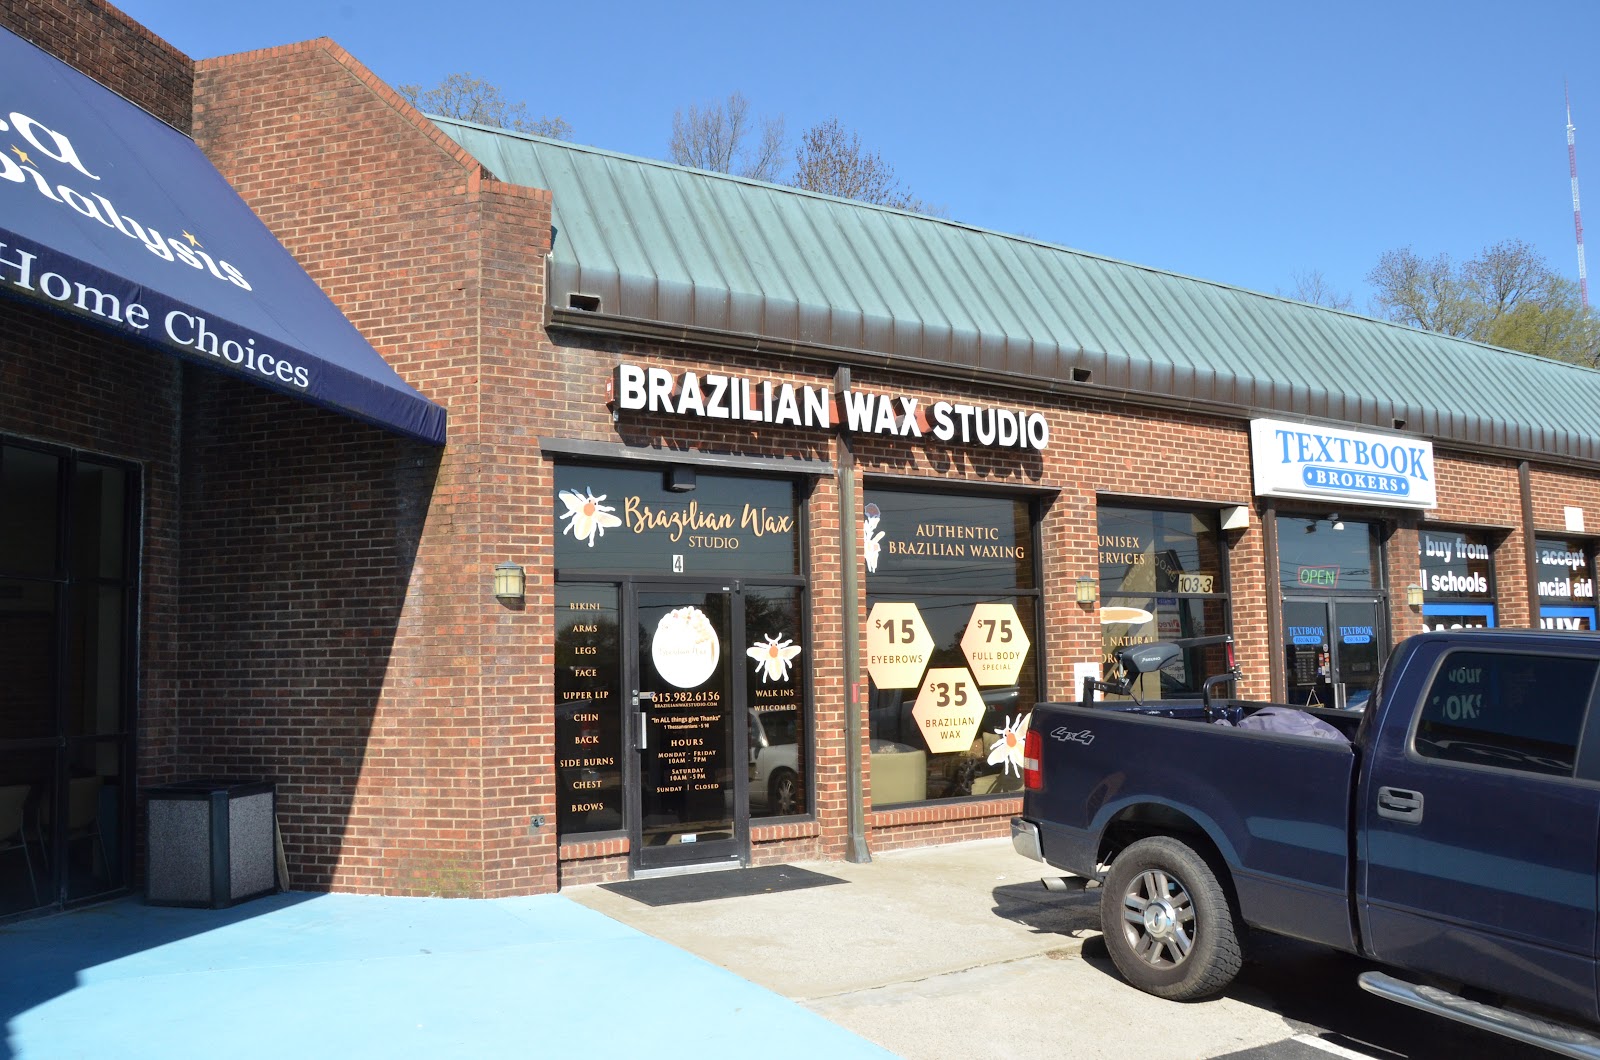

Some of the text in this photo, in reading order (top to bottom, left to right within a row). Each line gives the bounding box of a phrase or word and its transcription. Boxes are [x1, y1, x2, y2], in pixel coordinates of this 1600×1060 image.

[0, 242, 309, 388] Home Choices
[618, 364, 1049, 450] BRAZILIAN WAX STUDIO
[1275, 429, 1428, 481] TEXTBOOK
[1316, 469, 1398, 492] BROKERS
[624, 496, 794, 542] Brazilian Wax
[915, 524, 999, 541] AUTHENTIC
[688, 535, 739, 549] STUDIO
[1097, 535, 1139, 548] UNISEX
[888, 541, 1025, 559] BRAZILIAN WAXING
[1425, 535, 1452, 563] buy
[1455, 537, 1489, 560] from
[674, 555, 682, 572] 4
[1099, 551, 1145, 565] ERVICES
[1541, 548, 1586, 571] accept
[1300, 569, 1335, 585] OPEN
[1431, 570, 1488, 593] schools
[1538, 577, 1593, 597] ncial aid
[570, 602, 600, 610] BIKINI
[572, 624, 598, 633] ARMS
[875, 619, 915, 644] $15
[977, 619, 1013, 643] $75
[1288, 626, 1325, 637] TEXTBOOK
[1339, 626, 1374, 636] TEXTBOOK
[574, 646, 597, 655] LEGS
[972, 651, 1020, 660] FULL BODY
[871, 654, 923, 664] EYEBROWS
[575, 668, 597, 677] FACE
[563, 690, 609, 700] UPPER LIP
[651, 691, 720, 703] 615.982.6156
[755, 688, 795, 697] WALK INS
[930, 682, 968, 708] $35
[754, 703, 797, 711] WELCOMED
[573, 713, 599, 722] CHIN
[925, 716, 975, 728] BRAZILIAN
[575, 735, 599, 744] BACK
[940, 730, 961, 739] WAX
[1050, 726, 1095, 745] 4x4
[670, 738, 704, 747] HOURS
[560, 757, 614, 768] SIDE BURNS
[671, 767, 704, 775] SATURDAY
[573, 780, 602, 789] CHEST
[571, 802, 604, 812] BROWS
